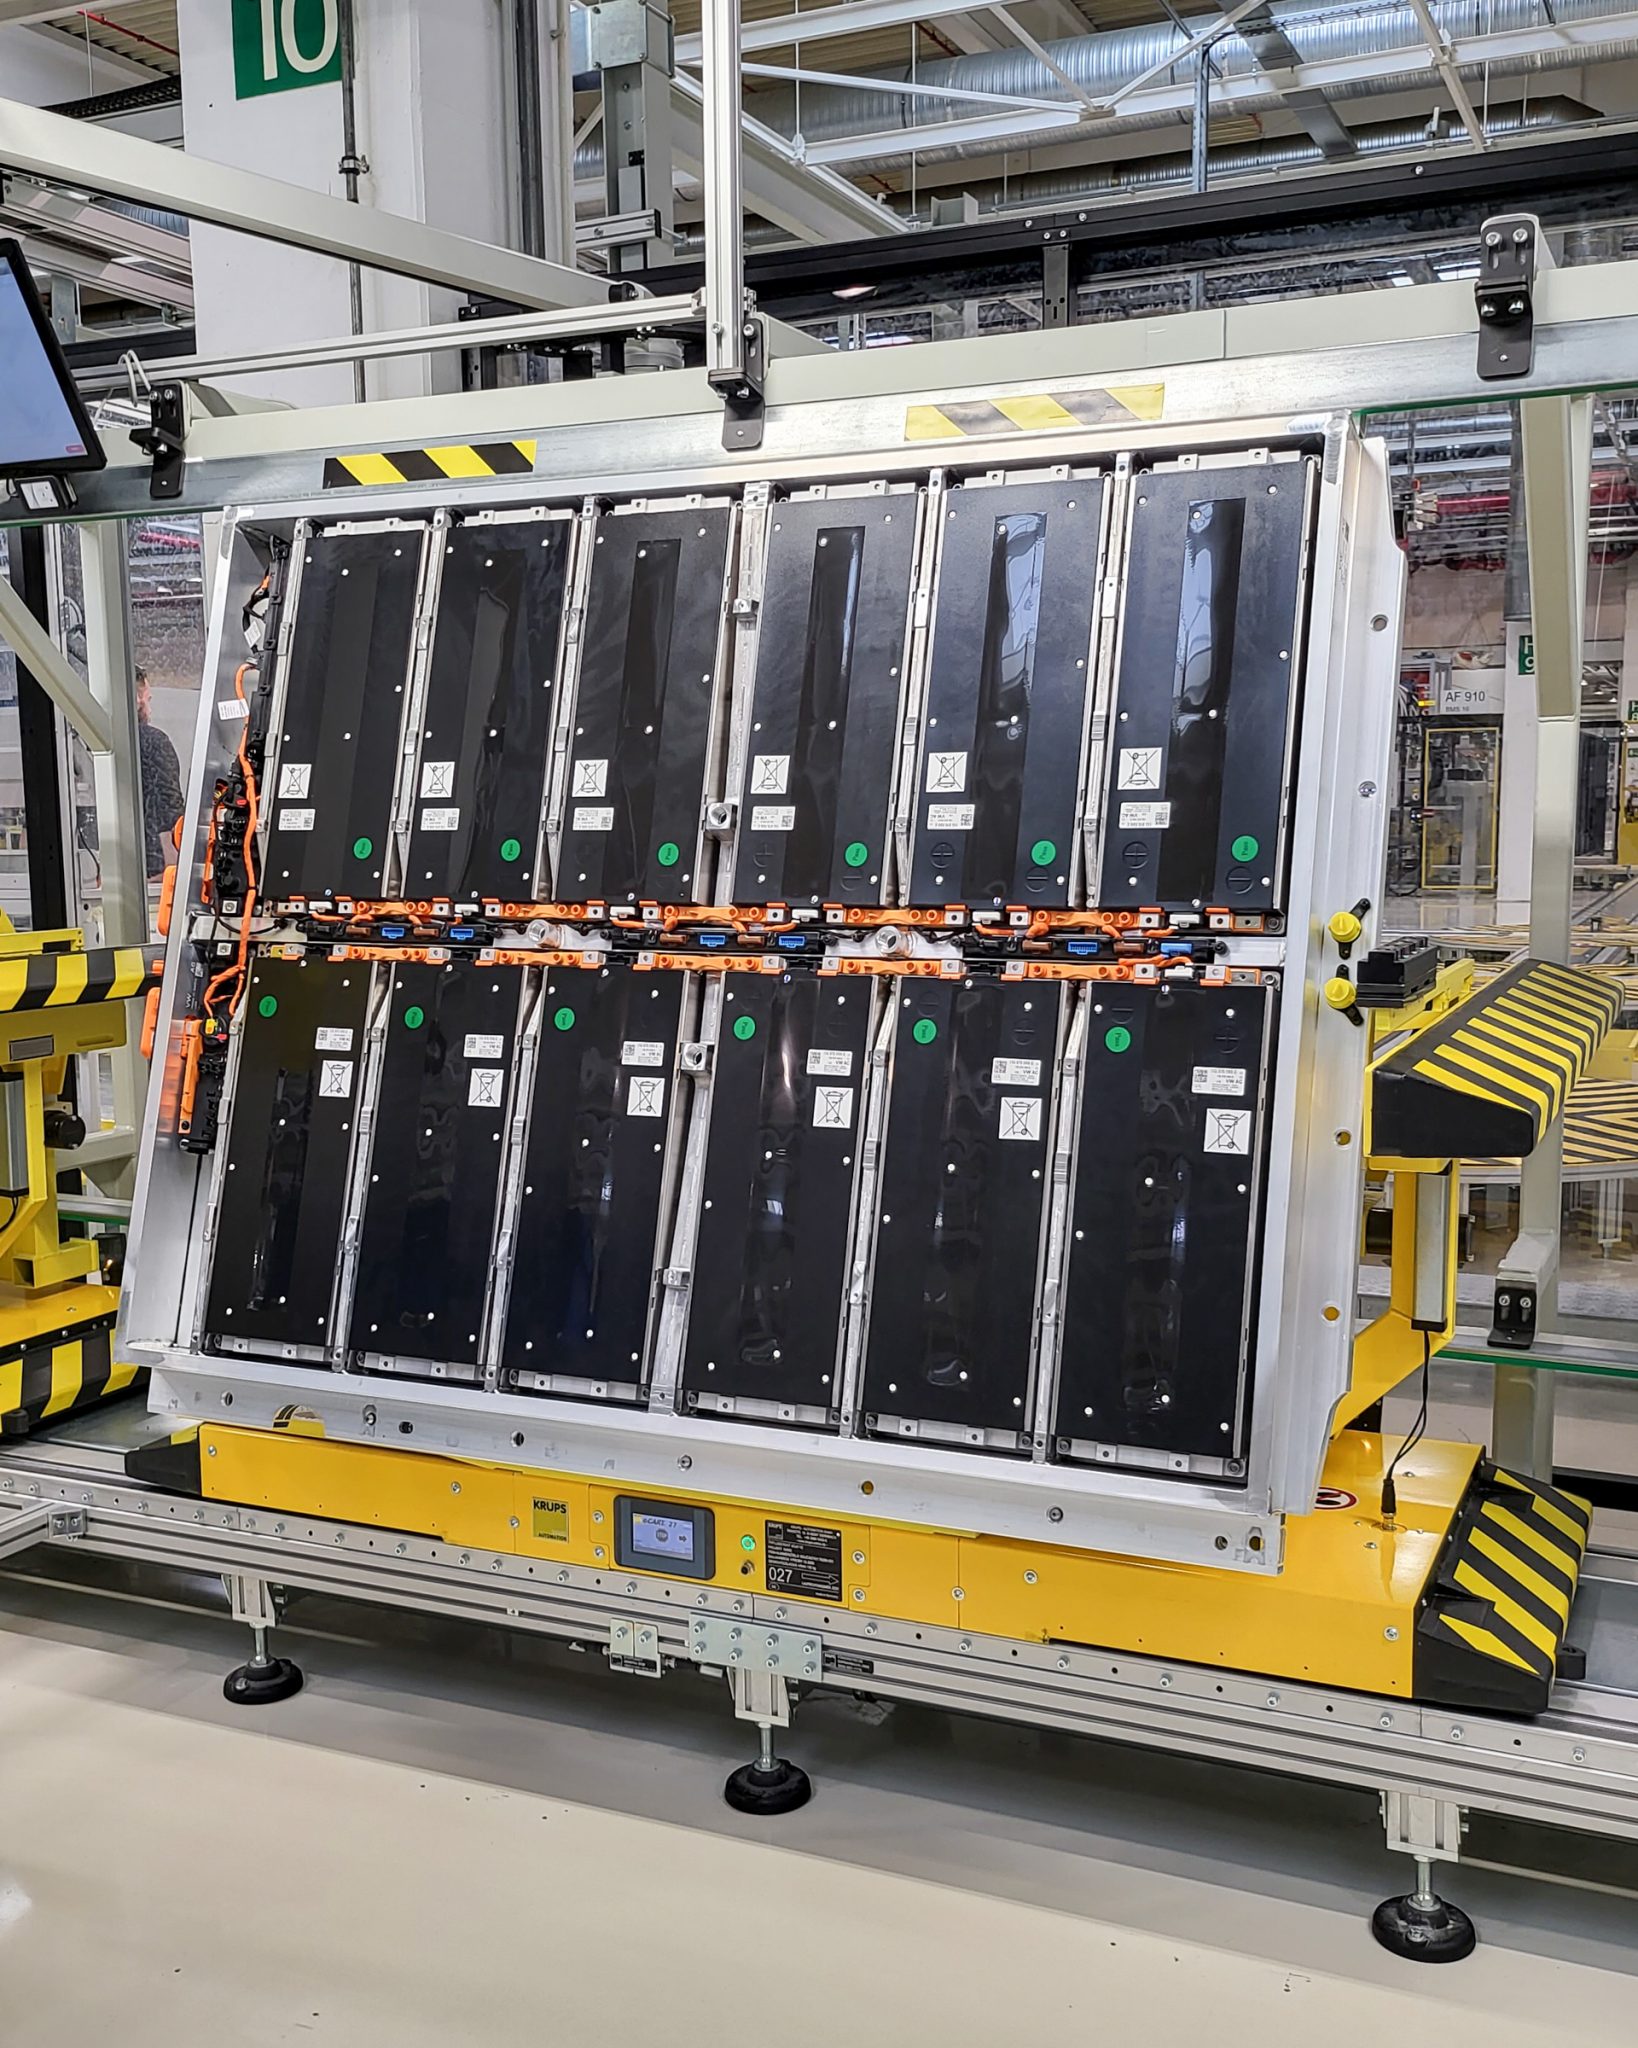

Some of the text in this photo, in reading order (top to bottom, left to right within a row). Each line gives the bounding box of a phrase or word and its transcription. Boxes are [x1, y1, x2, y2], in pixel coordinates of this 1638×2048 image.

[260, 0, 338, 80] 10
[1445, 691, 1485, 702] AF 910
[533, 1499, 567, 1514] KRUPS
[538, 1532, 567, 1542] AUTOMATION
[768, 1566, 793, 1583] 027
